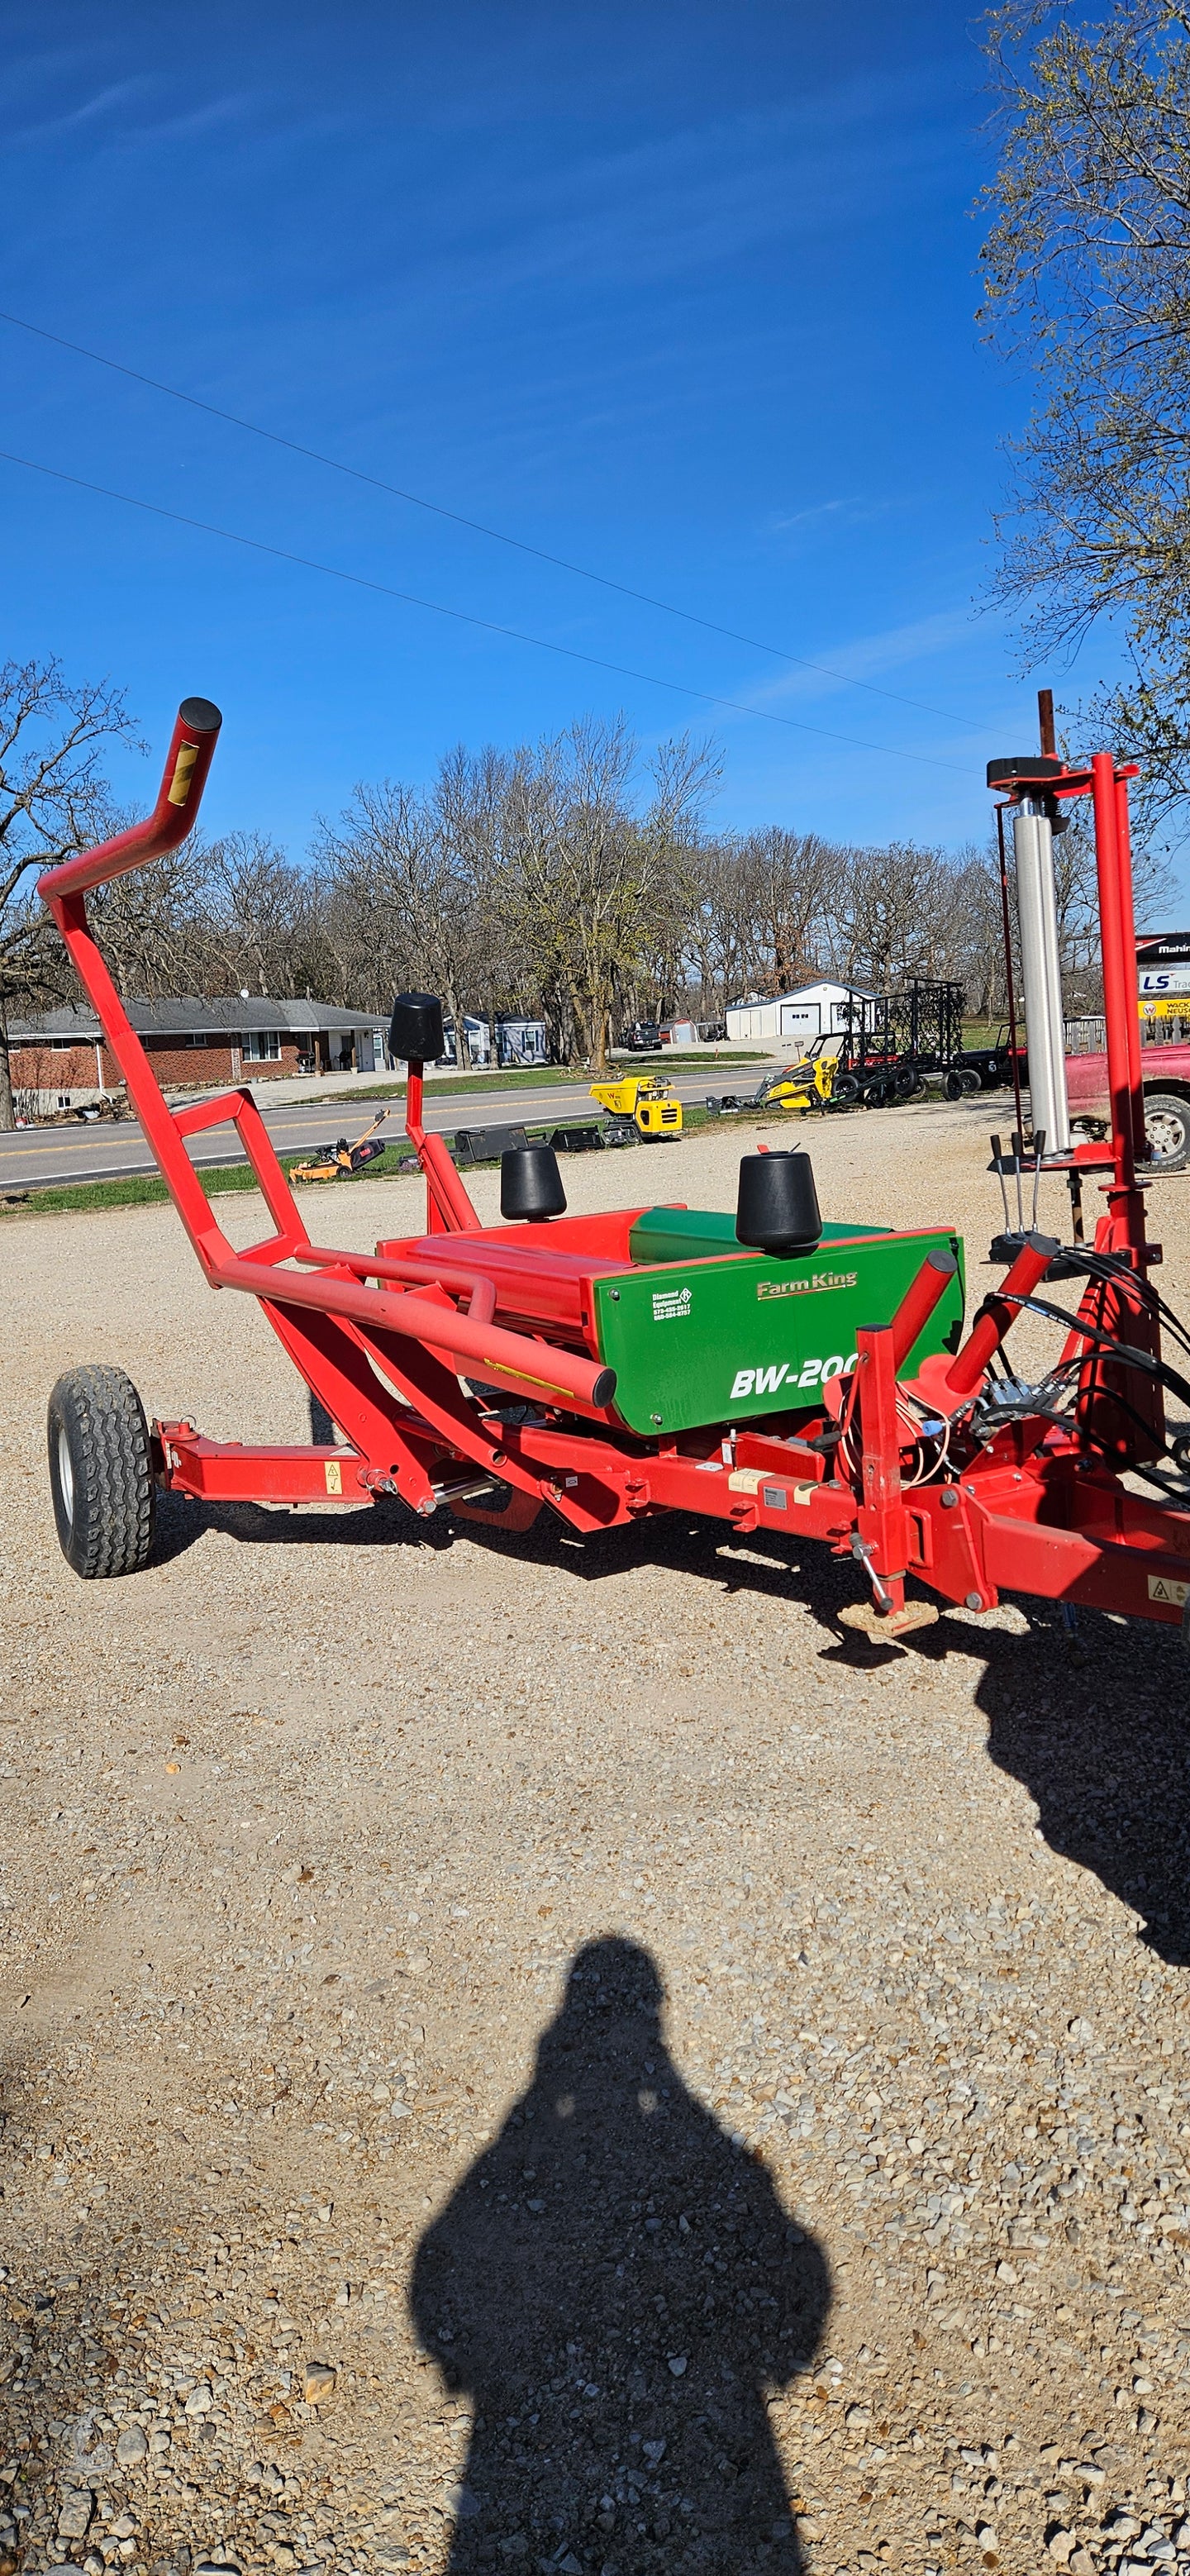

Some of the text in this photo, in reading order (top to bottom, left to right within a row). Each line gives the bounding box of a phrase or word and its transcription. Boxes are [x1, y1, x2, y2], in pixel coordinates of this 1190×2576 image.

[1143, 976, 1169, 990] LS
[757, 1272, 858, 1297] Farm King
[652, 1290, 678, 1301] Diamond
[653, 1298, 682, 1308] Equipment
